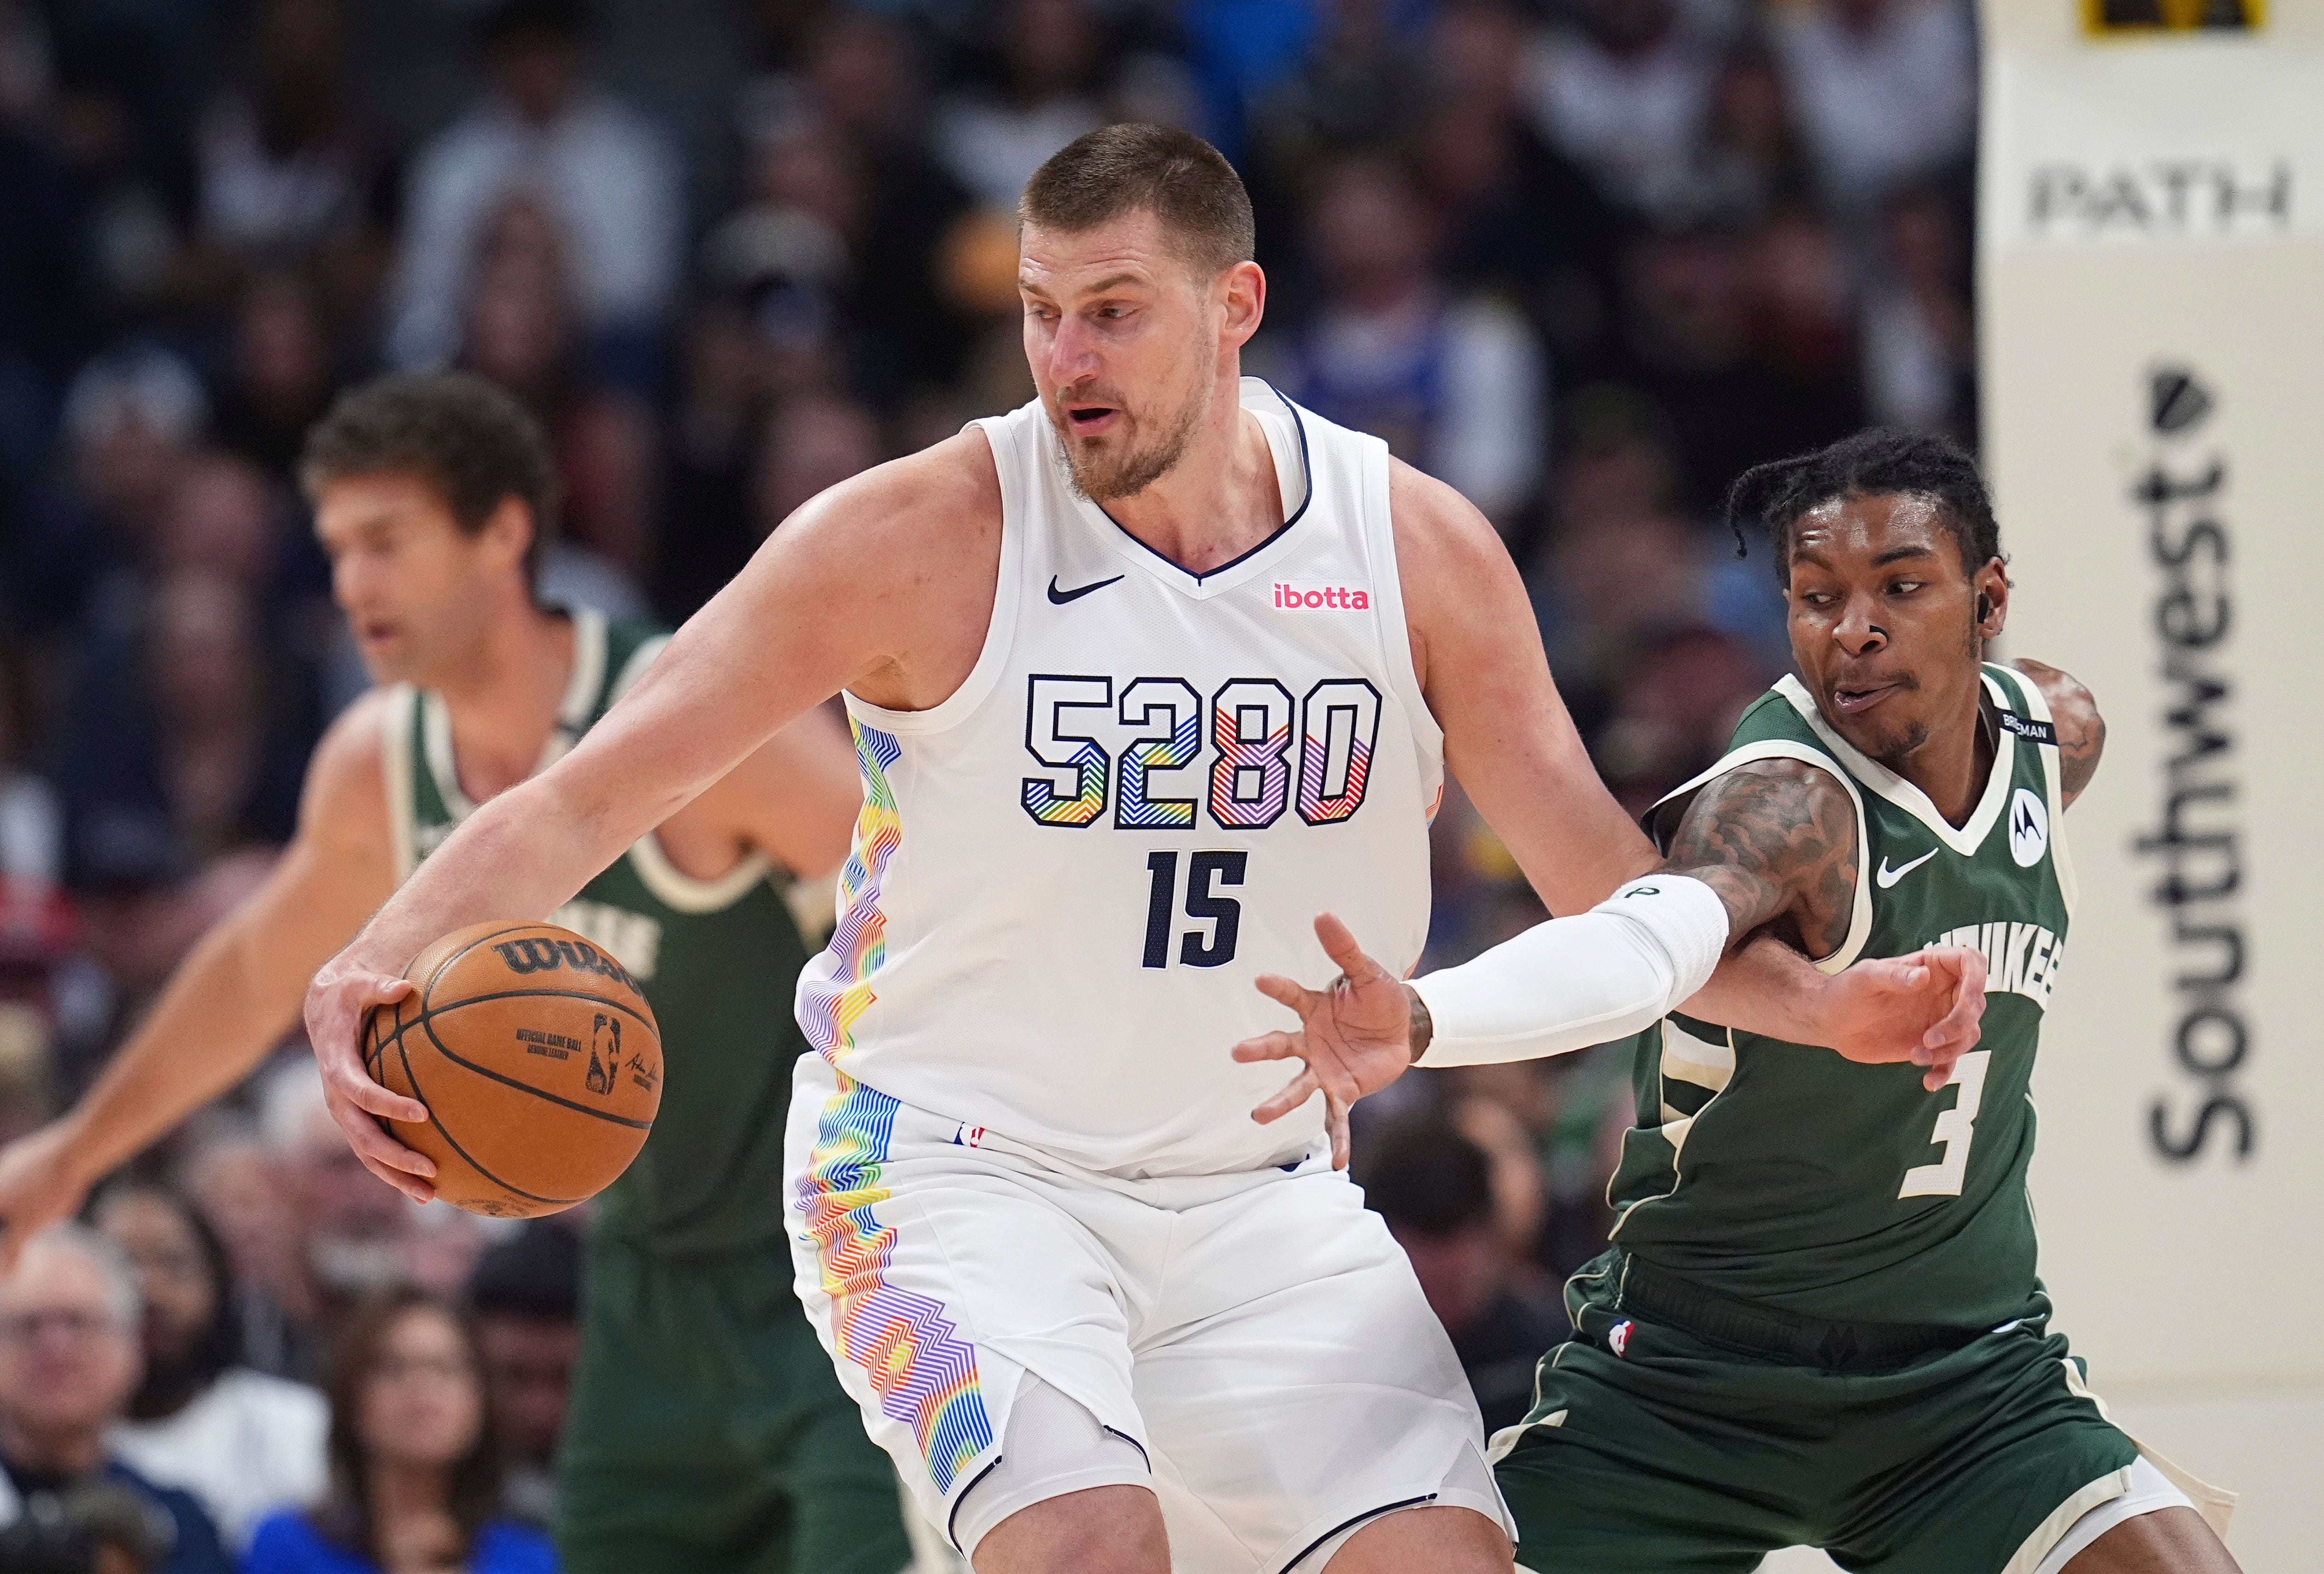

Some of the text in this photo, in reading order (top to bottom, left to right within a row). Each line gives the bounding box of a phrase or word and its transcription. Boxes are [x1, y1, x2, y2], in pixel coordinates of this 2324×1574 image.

[2030, 161, 2292, 234] PATH
[1275, 583, 1369, 609] ibotta
[1021, 674, 1382, 830] 5280
[2131, 457, 2258, 1168] Southwest
[1141, 849, 1249, 970] 15
[1897, 1050, 1992, 1200] 3
